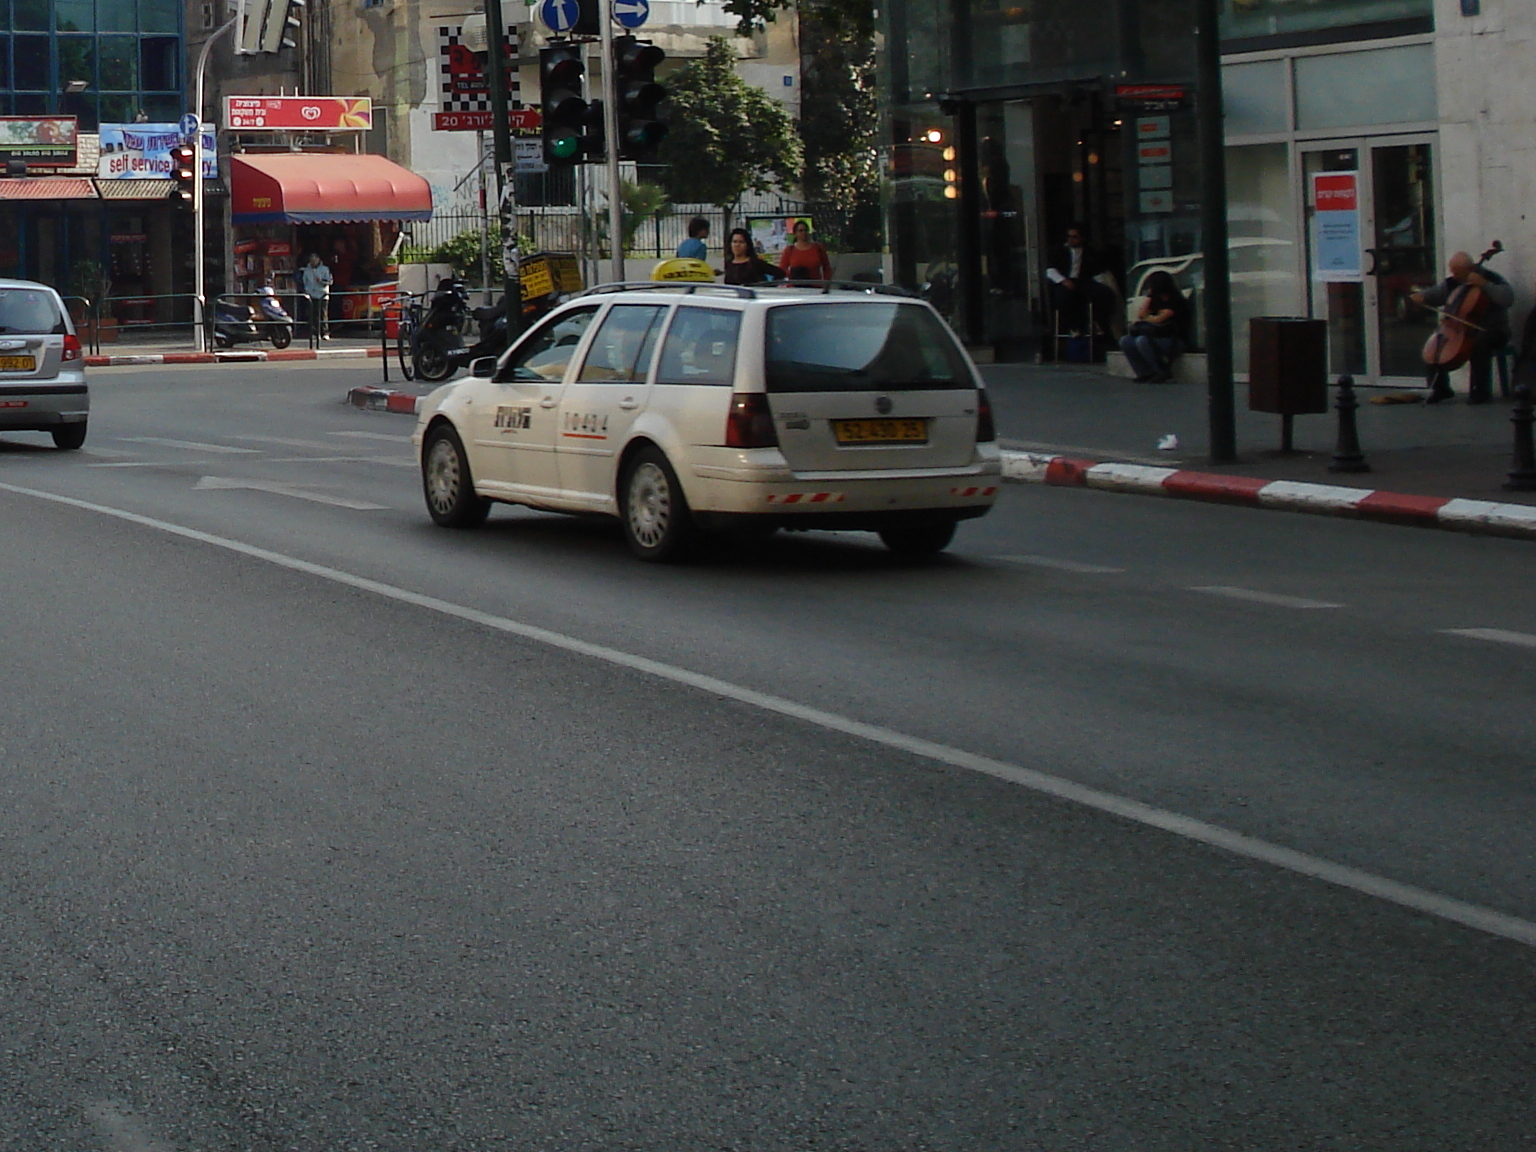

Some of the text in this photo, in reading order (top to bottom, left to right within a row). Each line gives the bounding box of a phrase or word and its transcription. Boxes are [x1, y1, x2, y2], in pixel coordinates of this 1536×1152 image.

[441, 116, 458, 127] 20
[109, 154, 129, 173] self
[131, 156, 170, 173] service
